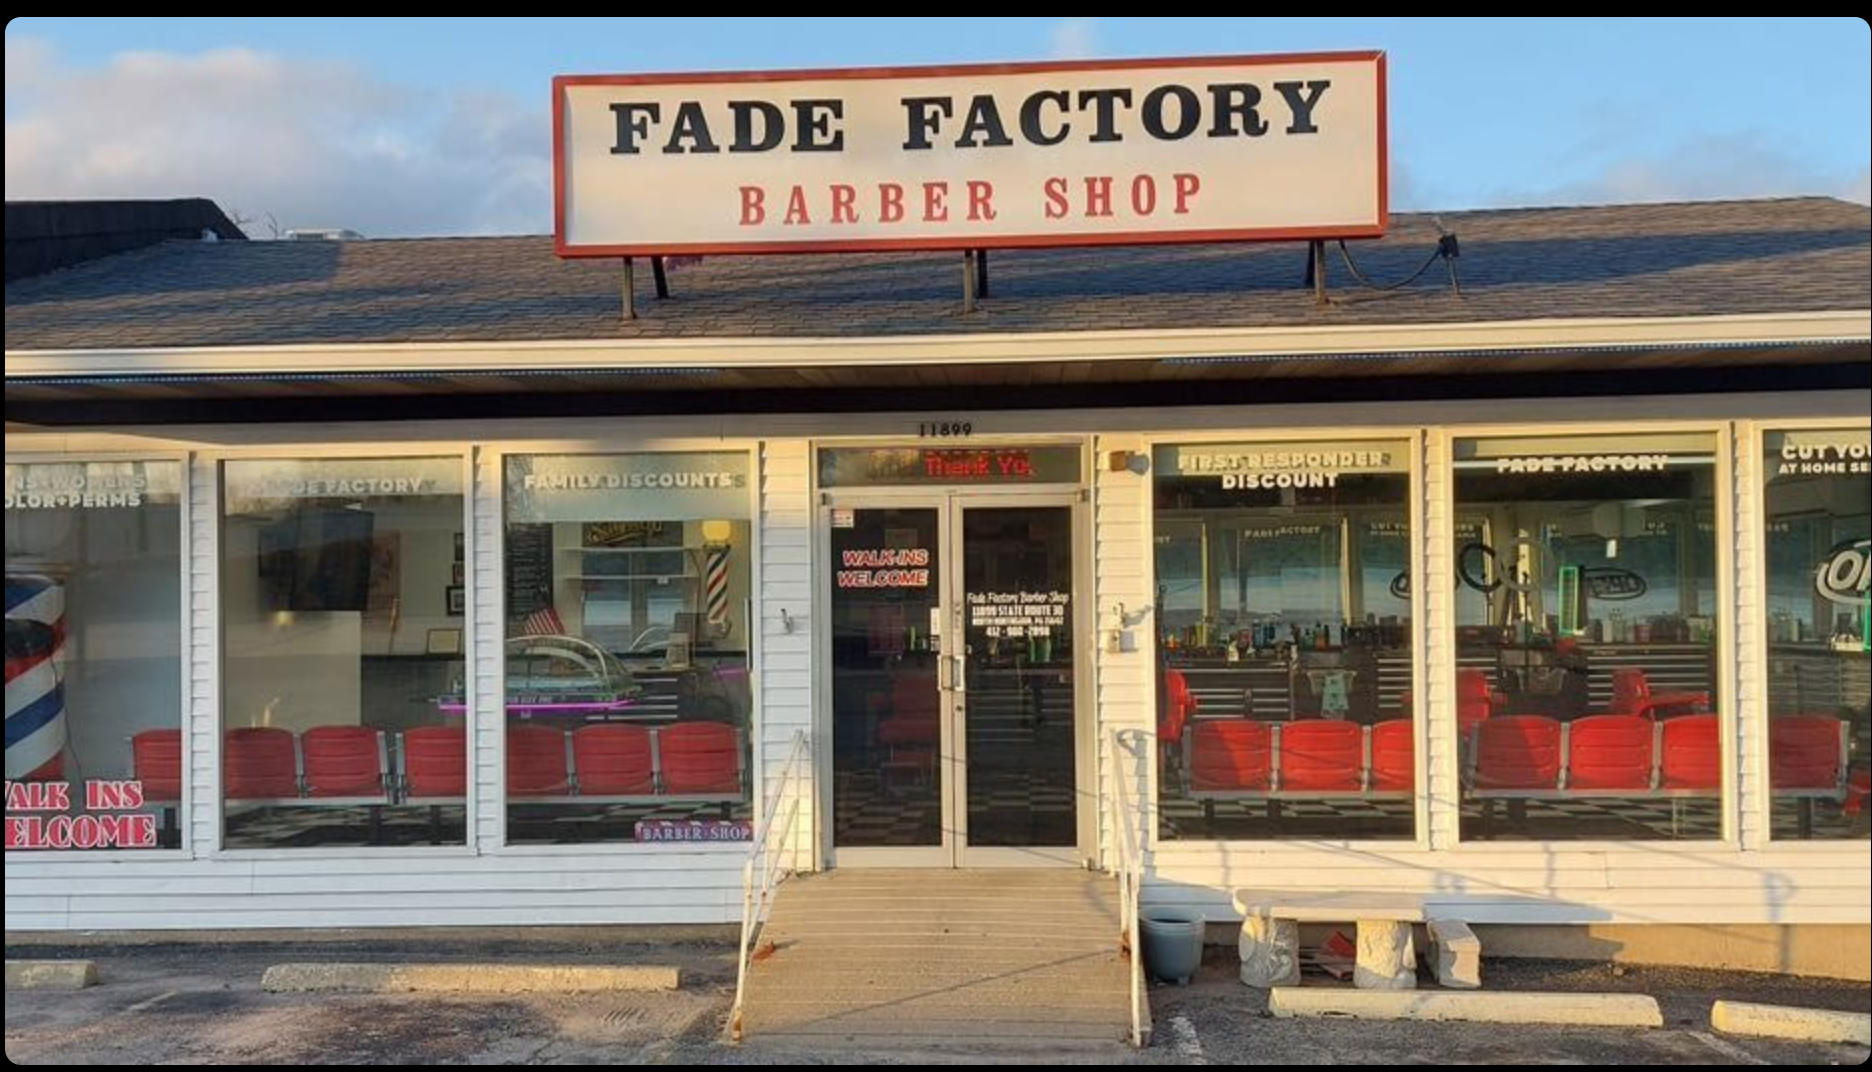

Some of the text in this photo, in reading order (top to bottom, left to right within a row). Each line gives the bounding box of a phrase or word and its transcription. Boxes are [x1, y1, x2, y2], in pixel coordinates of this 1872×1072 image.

[609, 80, 1331, 154] FADE FACTORY
[739, 174, 1200, 226] BARBER SHOP
[920, 422, 971, 436] 11899
[1782, 445, 1828, 459] CUT
[925, 454, 990, 475] Thank
[1178, 451, 1383, 470] FIRST RESPONDER
[1497, 455, 1668, 473] FADE FACTORY
[1779, 463, 1797, 474] AT
[1801, 462, 1846, 474] HOME
[325, 478, 422, 494] FACTORY
[525, 472, 732, 489] FAMILY DISCOUNTS
[1222, 473, 1339, 489] DISCOUNT
[69, 493, 141, 508] PERMS
[842, 549, 929, 567] WALK-INS
[837, 569, 930, 588] WELCOME
[987, 592, 1018, 605] Factory
[1020, 591, 1047, 604] Barber
[1048, 591, 1070, 605] Shop
[999, 605, 1022, 616] STATE
[1025, 604, 1051, 616] ROUTE
[85, 780, 144, 810] INS
[643, 826, 750, 840] BARBER SHOP
